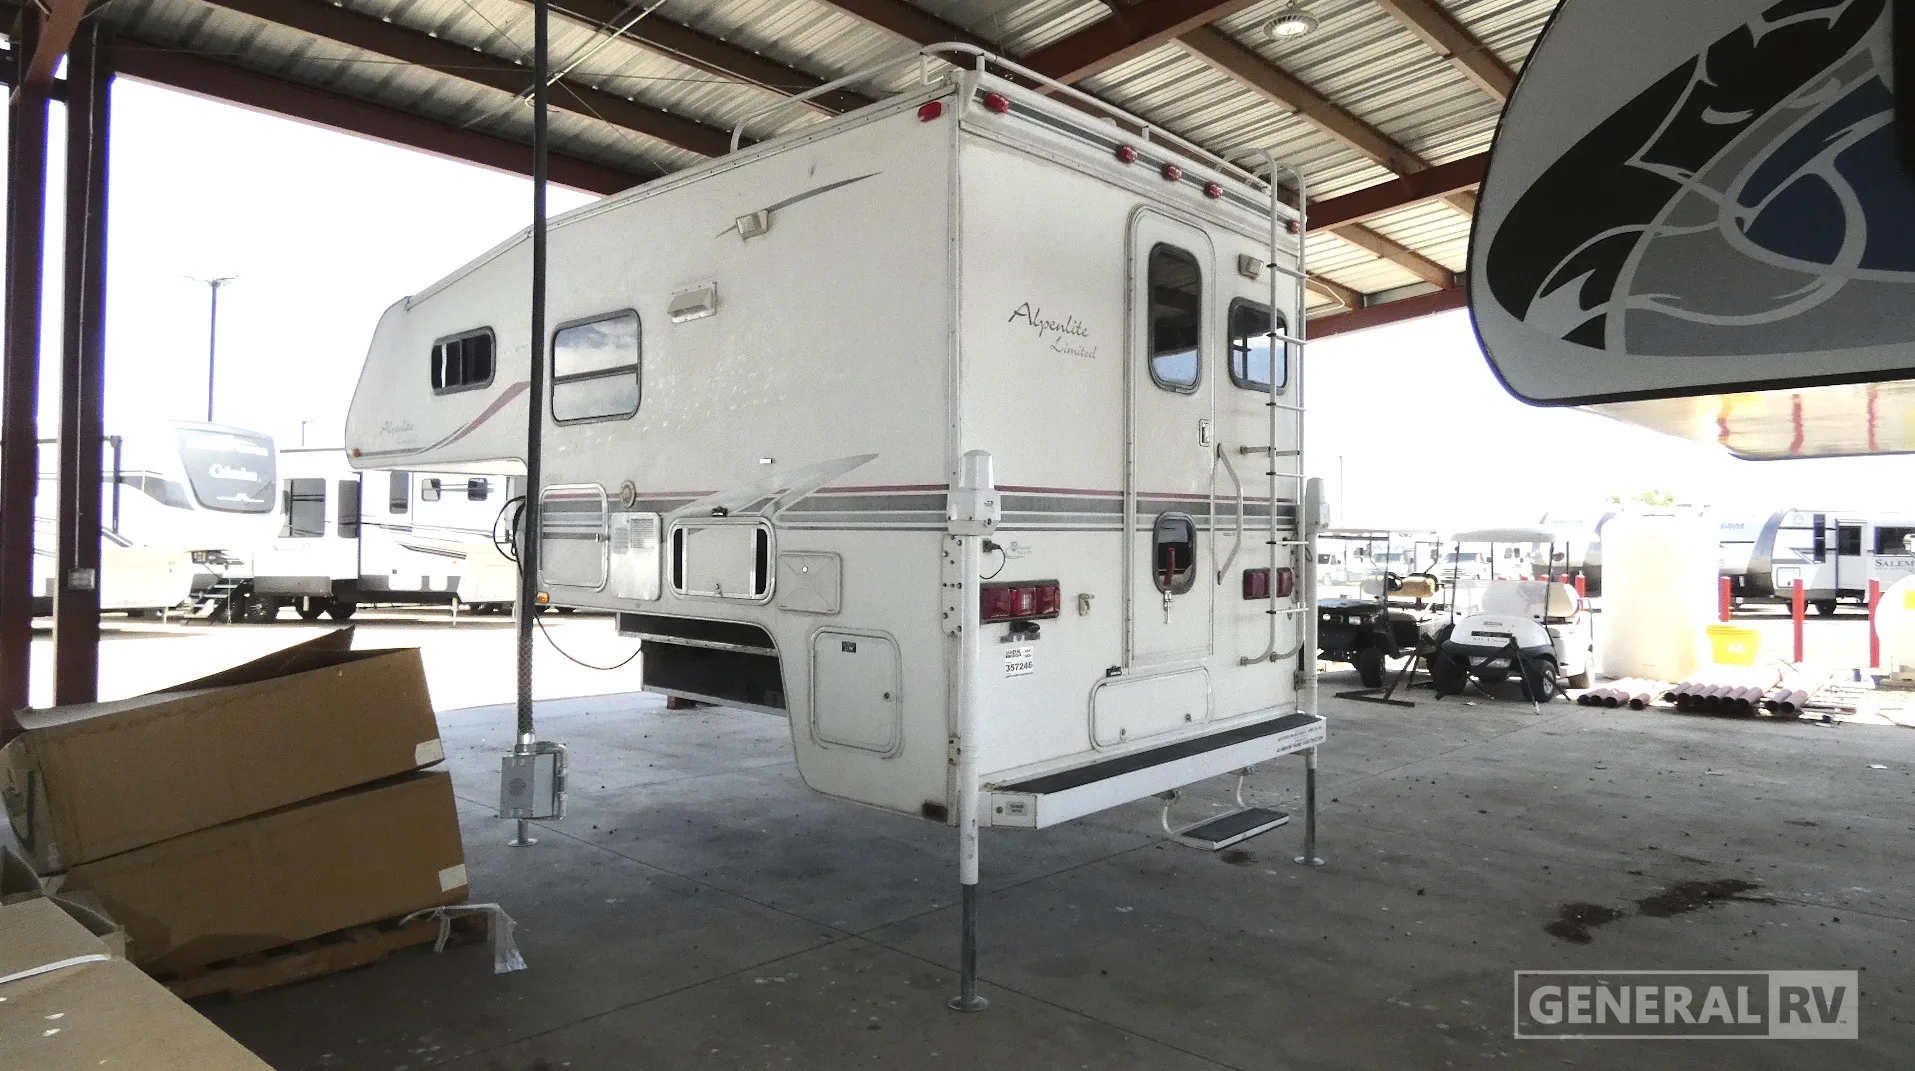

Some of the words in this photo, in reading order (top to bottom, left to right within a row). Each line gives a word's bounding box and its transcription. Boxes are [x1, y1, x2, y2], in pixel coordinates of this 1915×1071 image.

[1008, 302, 1089, 337] Alpenlite
[1051, 336, 1097, 359] Limited
[1005, 661, 1033, 673] 357246
